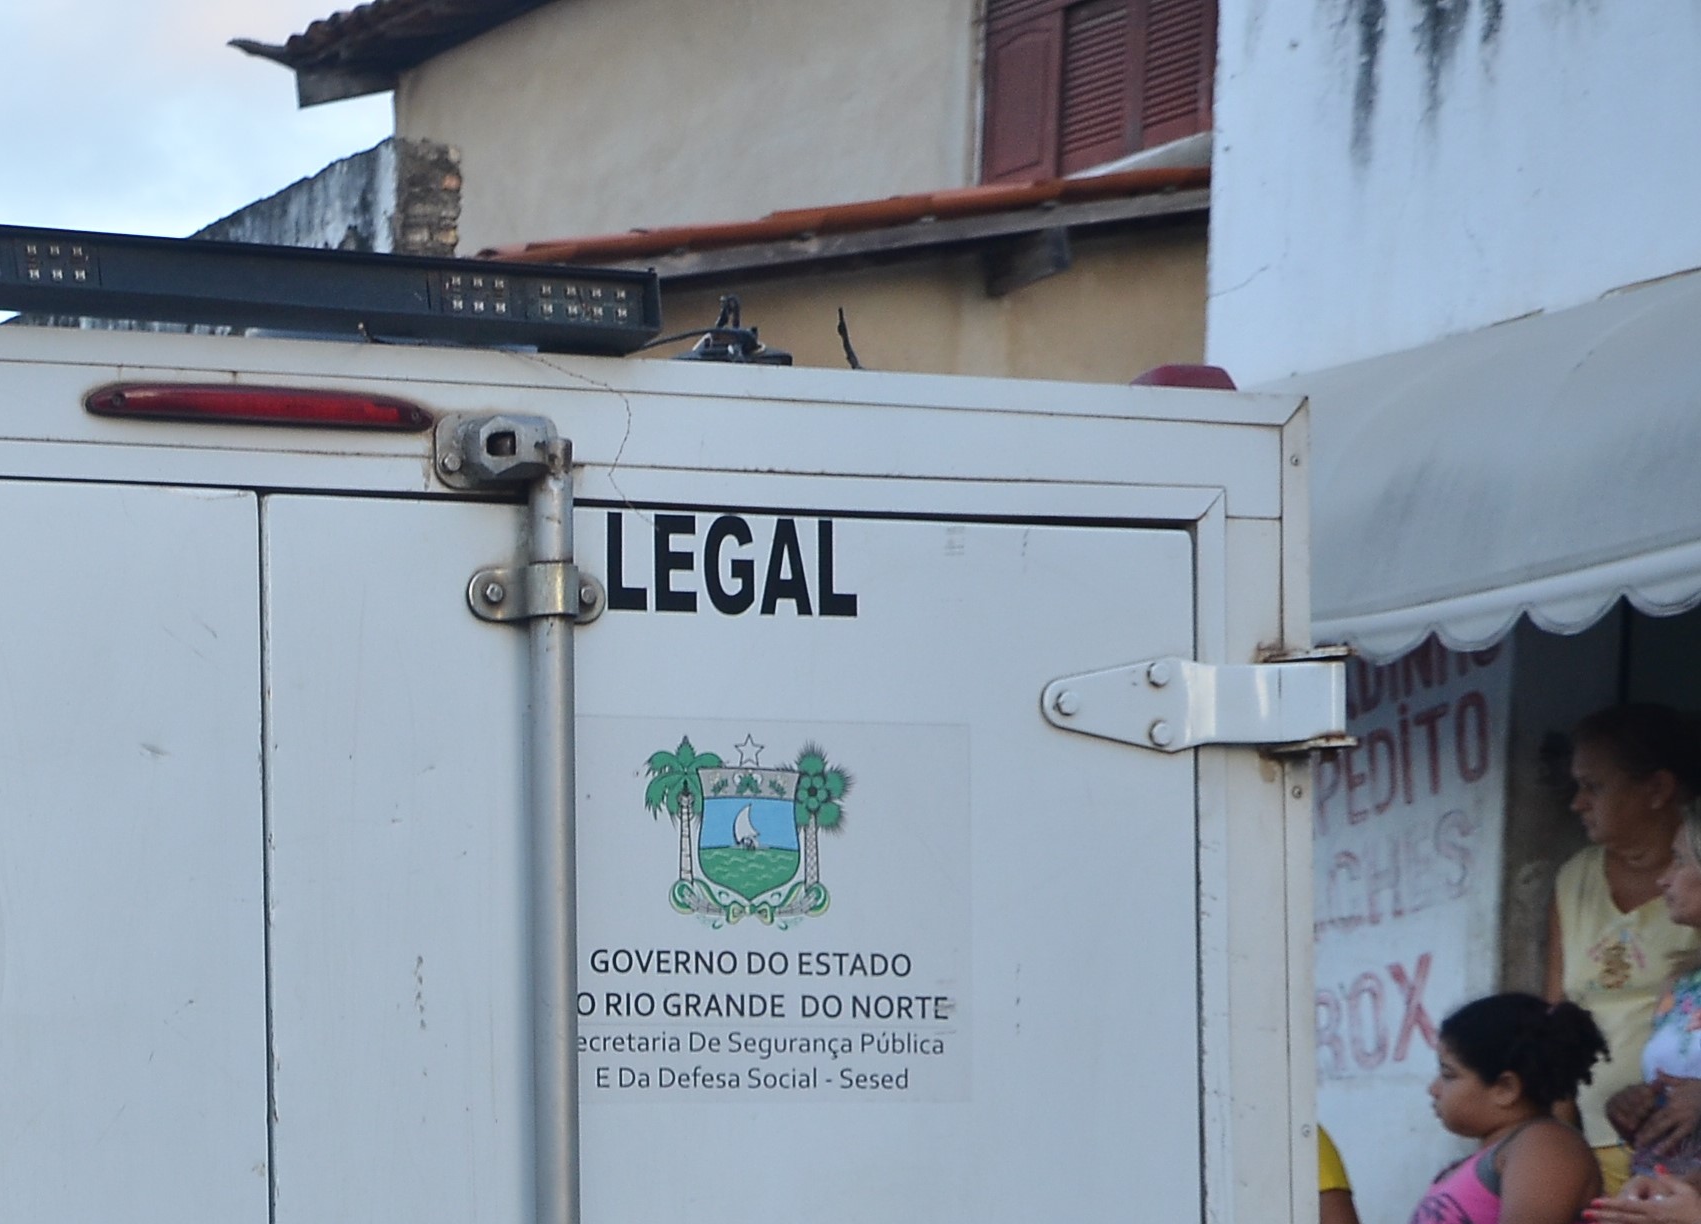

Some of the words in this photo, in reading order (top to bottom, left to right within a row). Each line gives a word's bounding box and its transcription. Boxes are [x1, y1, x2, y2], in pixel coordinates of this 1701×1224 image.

[607, 512, 858, 617] LEGAL
[590, 949, 738, 975] GOVERNO
[747, 951, 789, 976] DO
[798, 952, 912, 977] ESTADO
[577, 992, 596, 1017] O
[605, 992, 655, 1017] RIO
[663, 993, 785, 1018] GRANDE
[801, 995, 842, 1019] DO
[852, 995, 949, 1020] NORTE
[577, 1031, 681, 1054] ecretaria
[688, 1032, 721, 1054] De
[728, 1032, 852, 1060] Segurança
[860, 1030, 944, 1055] Pública
[596, 1067, 610, 1088] E
[619, 1067, 650, 1089] Da
[659, 1066, 740, 1089] Defesa
[747, 1066, 817, 1090] Social
[839, 1067, 909, 1090] Sesed
